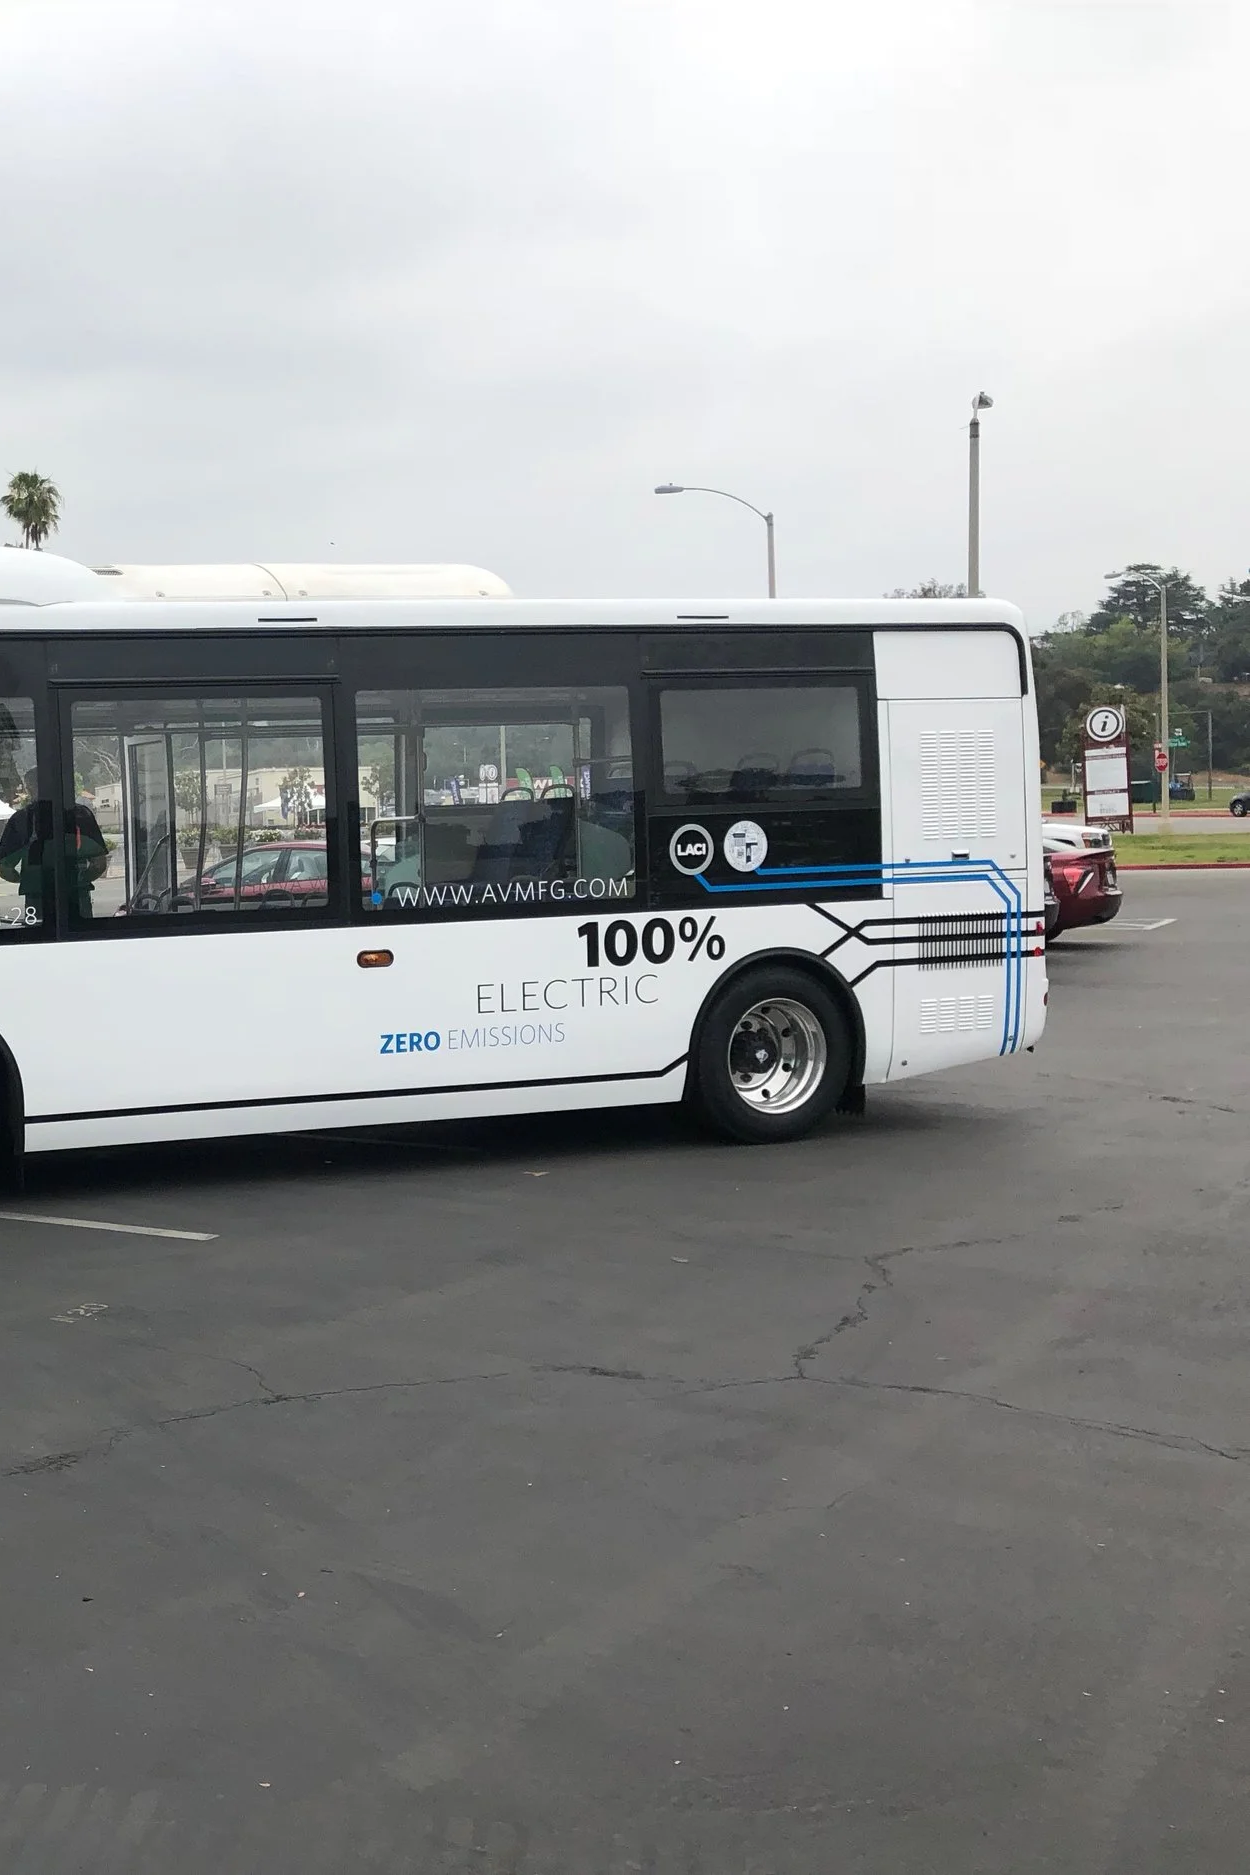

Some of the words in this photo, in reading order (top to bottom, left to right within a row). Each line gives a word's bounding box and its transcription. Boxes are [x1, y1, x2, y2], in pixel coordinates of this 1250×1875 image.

[677, 843, 706, 856] LACI
[396, 878, 628, 908] WWW.AVMFG.COM
[577, 915, 726, 967] 100%
[477, 974, 659, 1014] ELECTRIC
[379, 1030, 441, 1054] ZERO
[448, 1022, 566, 1051] EMISSIONS
